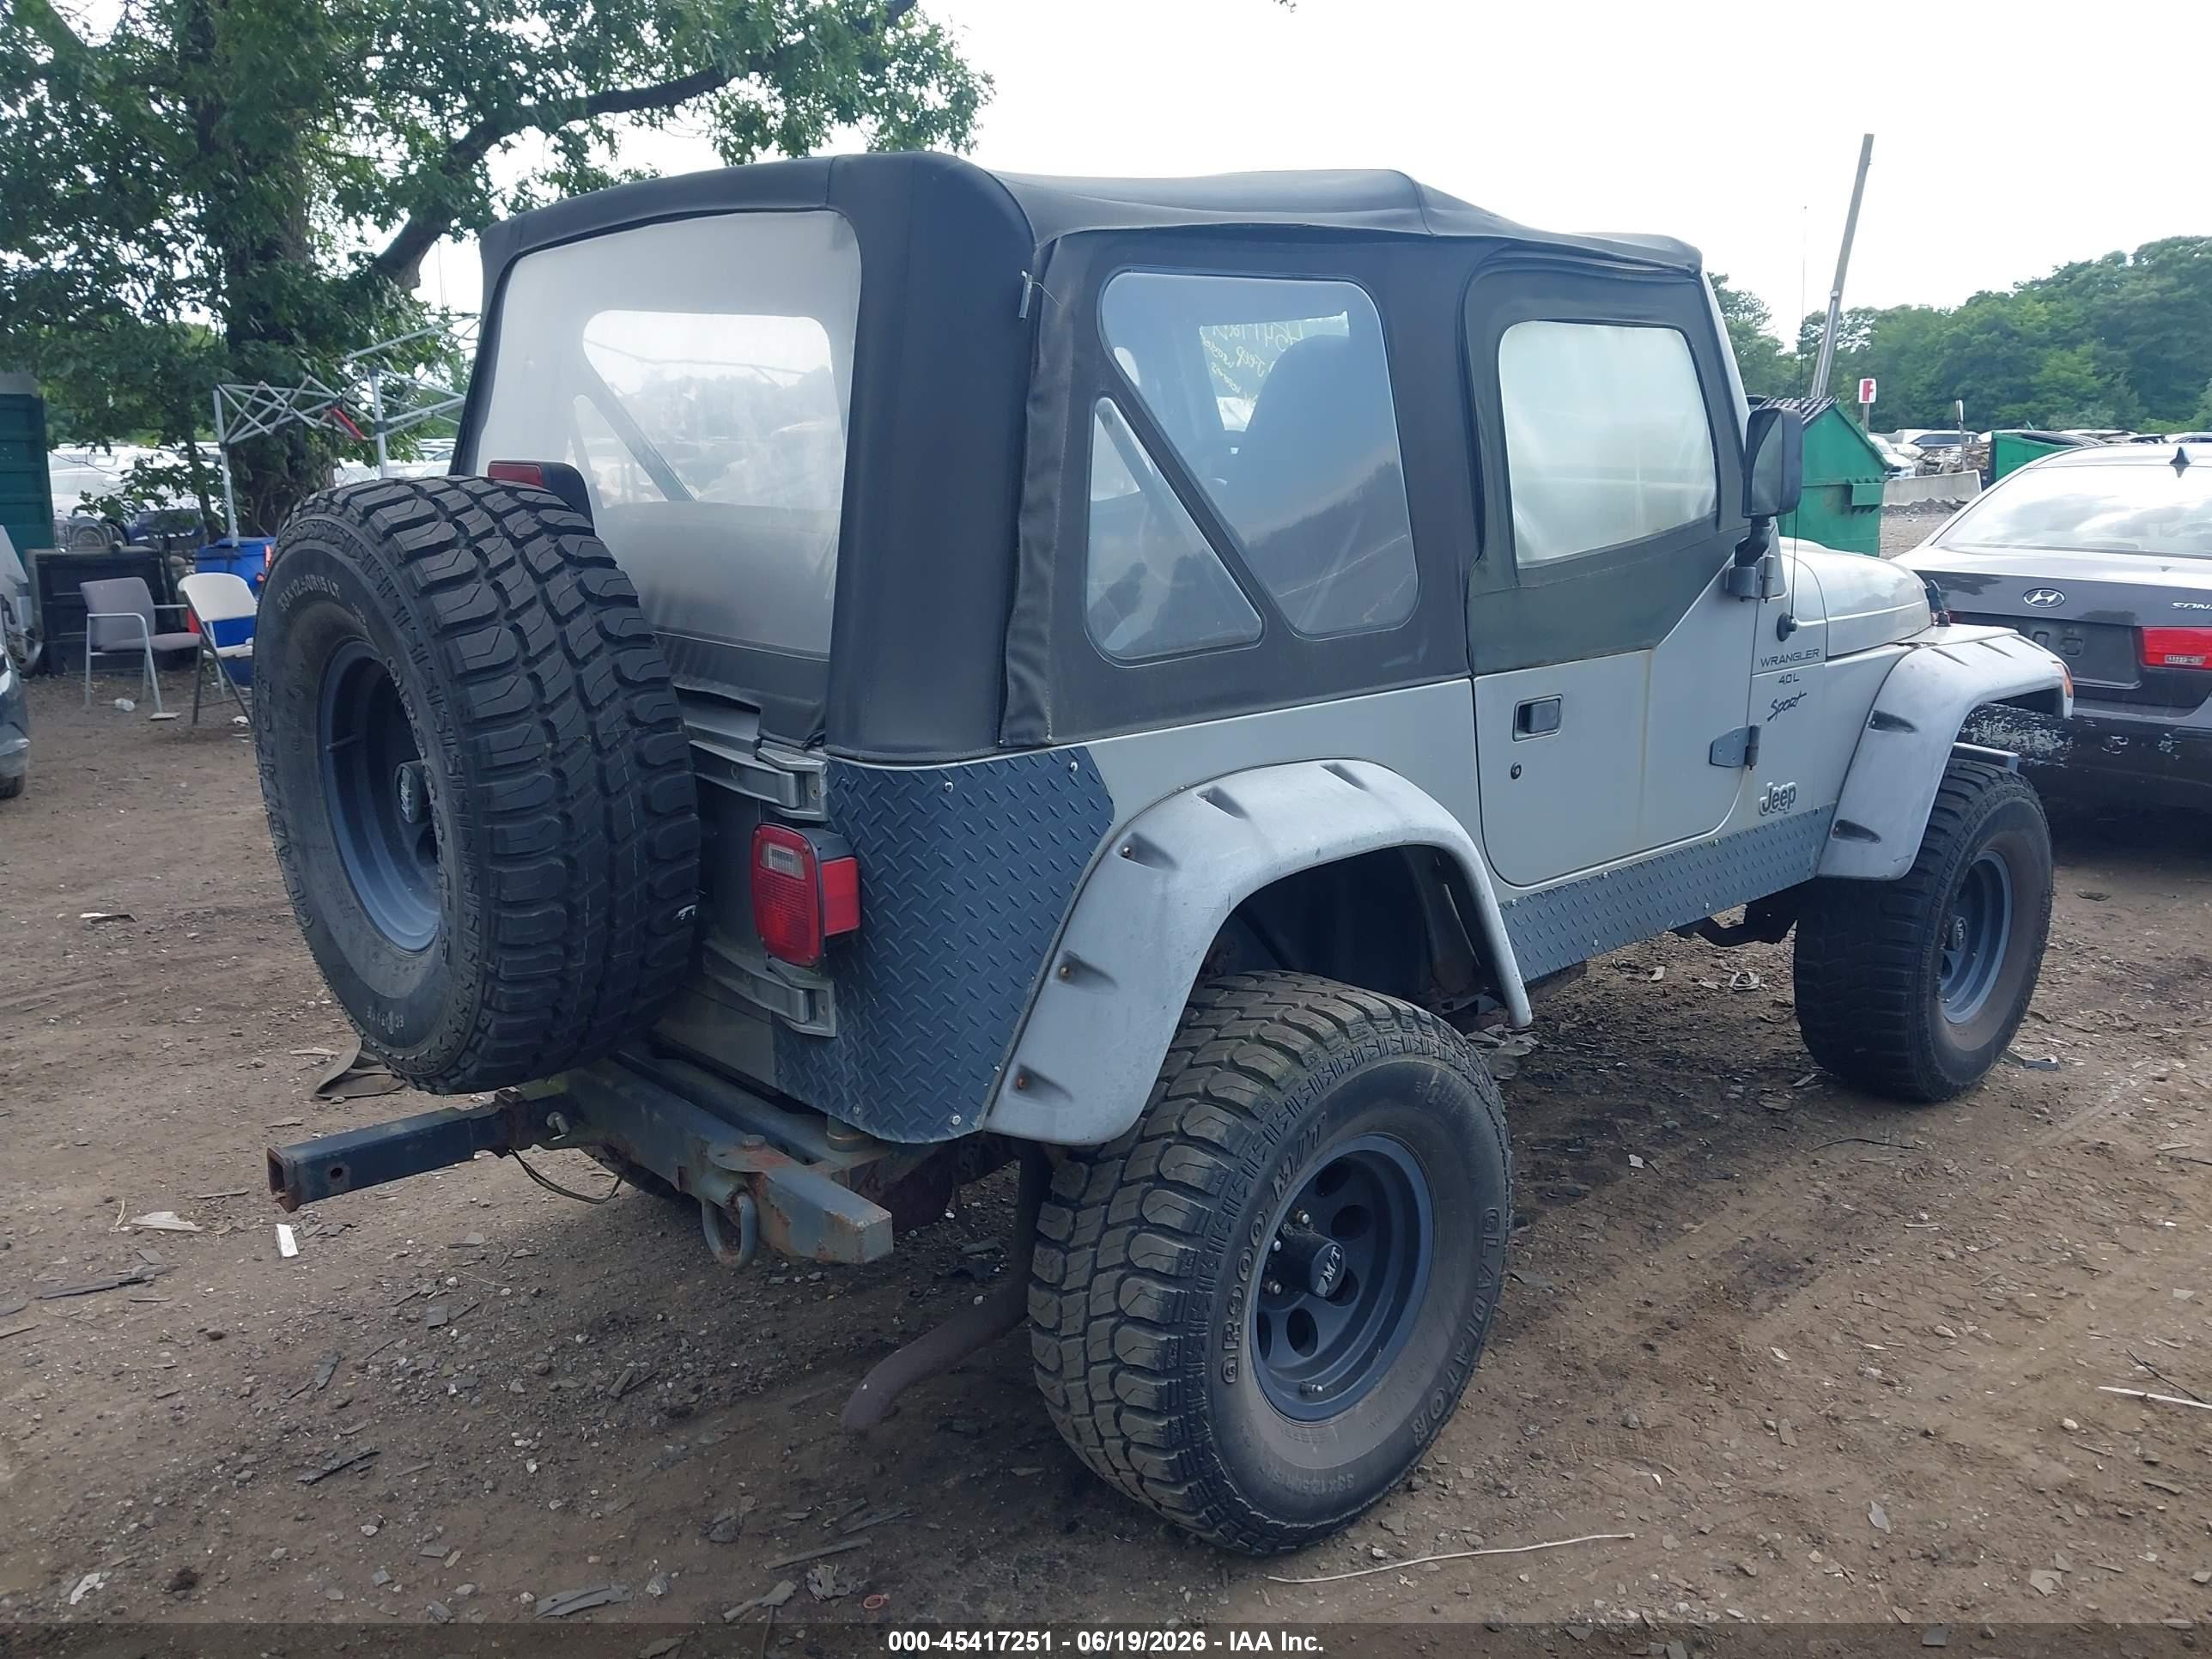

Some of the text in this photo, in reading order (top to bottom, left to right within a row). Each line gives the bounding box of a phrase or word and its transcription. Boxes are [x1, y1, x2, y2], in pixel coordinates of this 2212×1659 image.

[2171, 602, 2212, 611] SON
[1760, 648, 1820, 667] WRANGLER
[1760, 781, 1796, 816] Jeep
[1322, 1246, 1340, 1282] M/T
[1411, 1207, 1501, 1449] GLADIATOR
